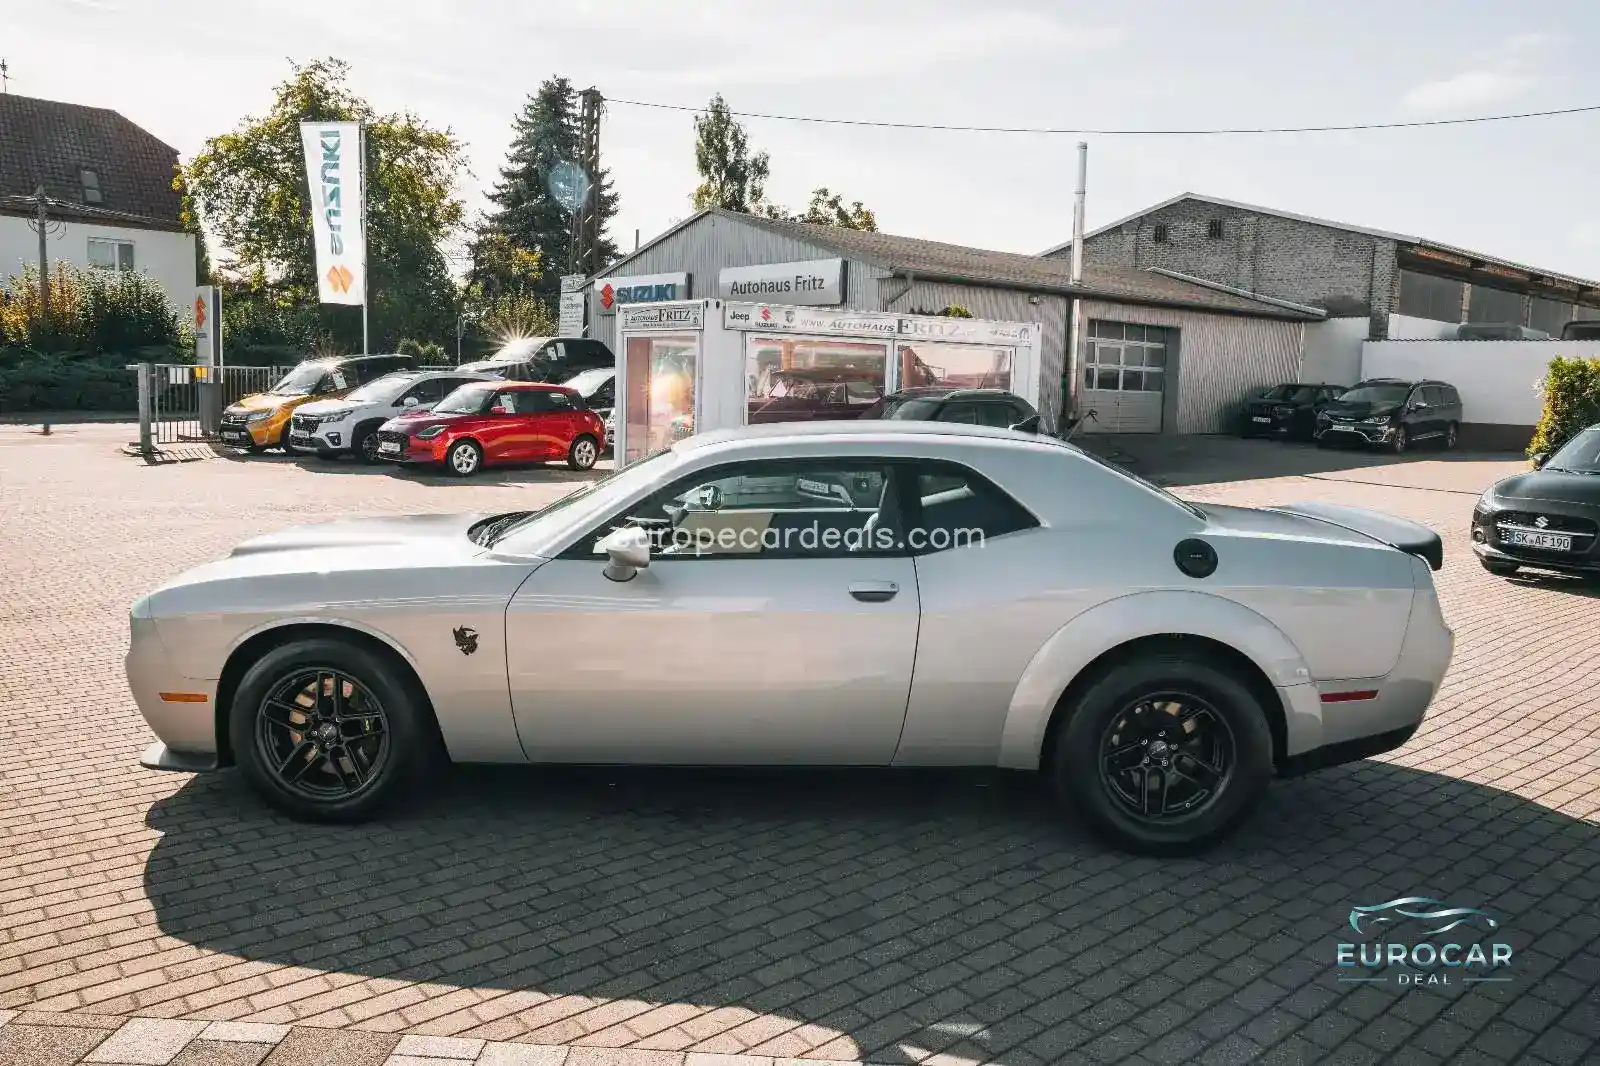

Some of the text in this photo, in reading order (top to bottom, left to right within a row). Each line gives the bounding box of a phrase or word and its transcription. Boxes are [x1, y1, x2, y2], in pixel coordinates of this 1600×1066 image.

[616, 283, 677, 304] SUZUKI
[730, 275, 825, 295] Autohaus Fritz
[730, 311, 750, 323] Jeep
[1515, 533, 1570, 548] SK AF 190
